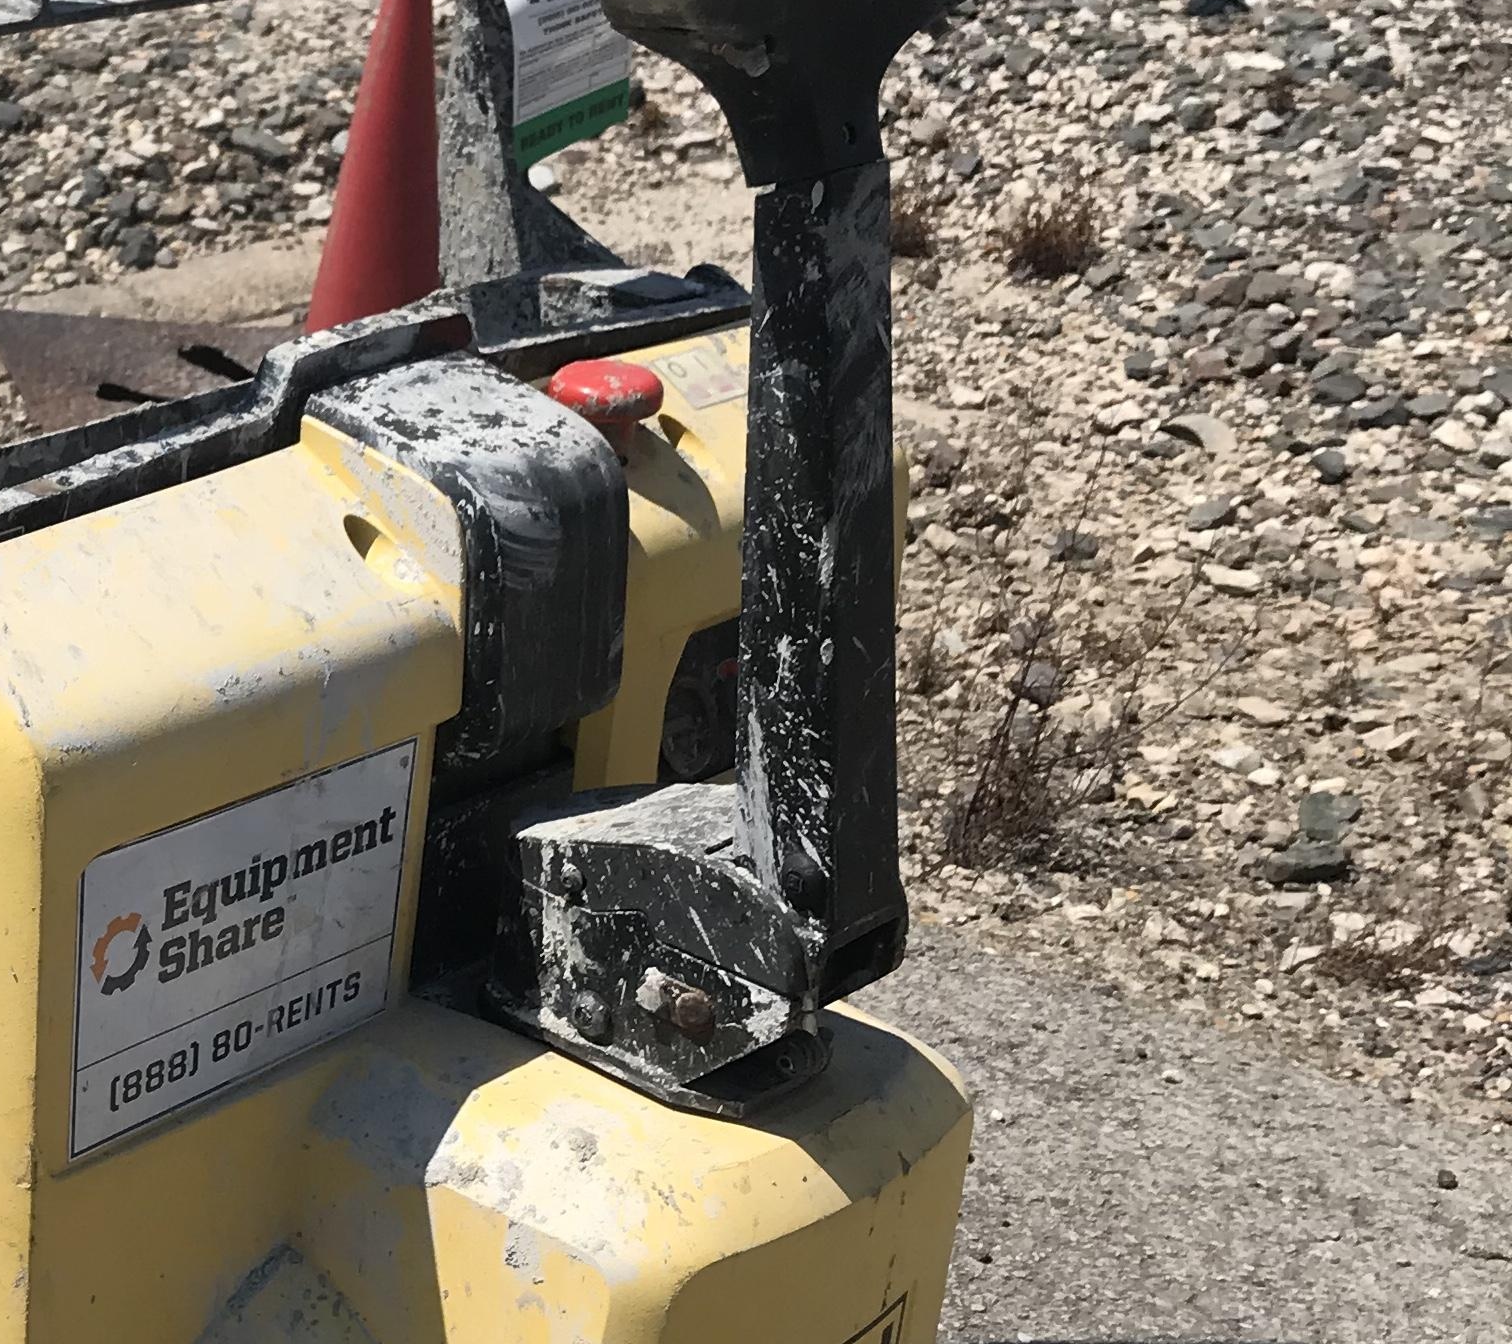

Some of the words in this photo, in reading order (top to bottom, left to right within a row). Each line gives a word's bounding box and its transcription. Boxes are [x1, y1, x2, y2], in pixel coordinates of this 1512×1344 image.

[160, 806, 398, 932] Equipment
[157, 905, 286, 984] Share
[109, 1042, 200, 1112] (888)
[211, 971, 363, 1064] 80-RENTS
